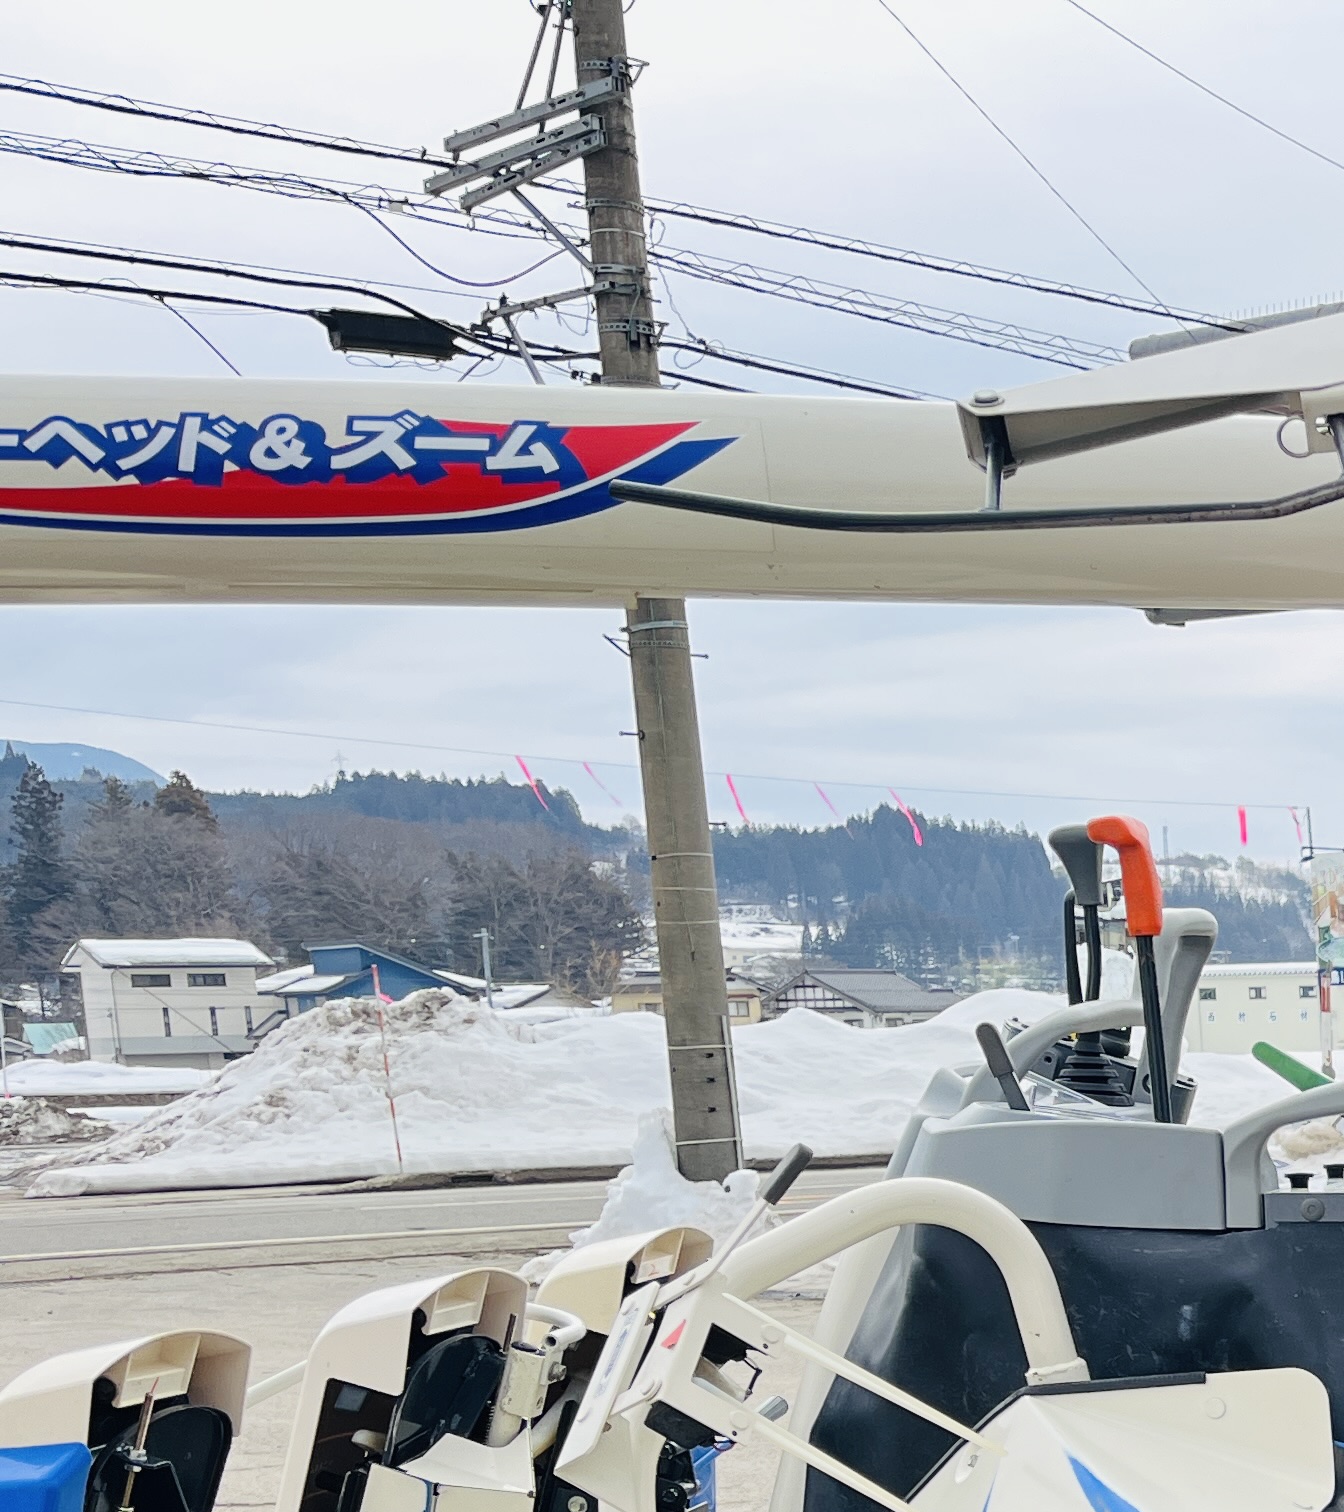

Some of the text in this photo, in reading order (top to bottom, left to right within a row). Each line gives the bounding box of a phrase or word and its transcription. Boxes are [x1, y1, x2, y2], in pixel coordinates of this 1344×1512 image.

[0, 410, 560, 476] ヘッド&ズーム
